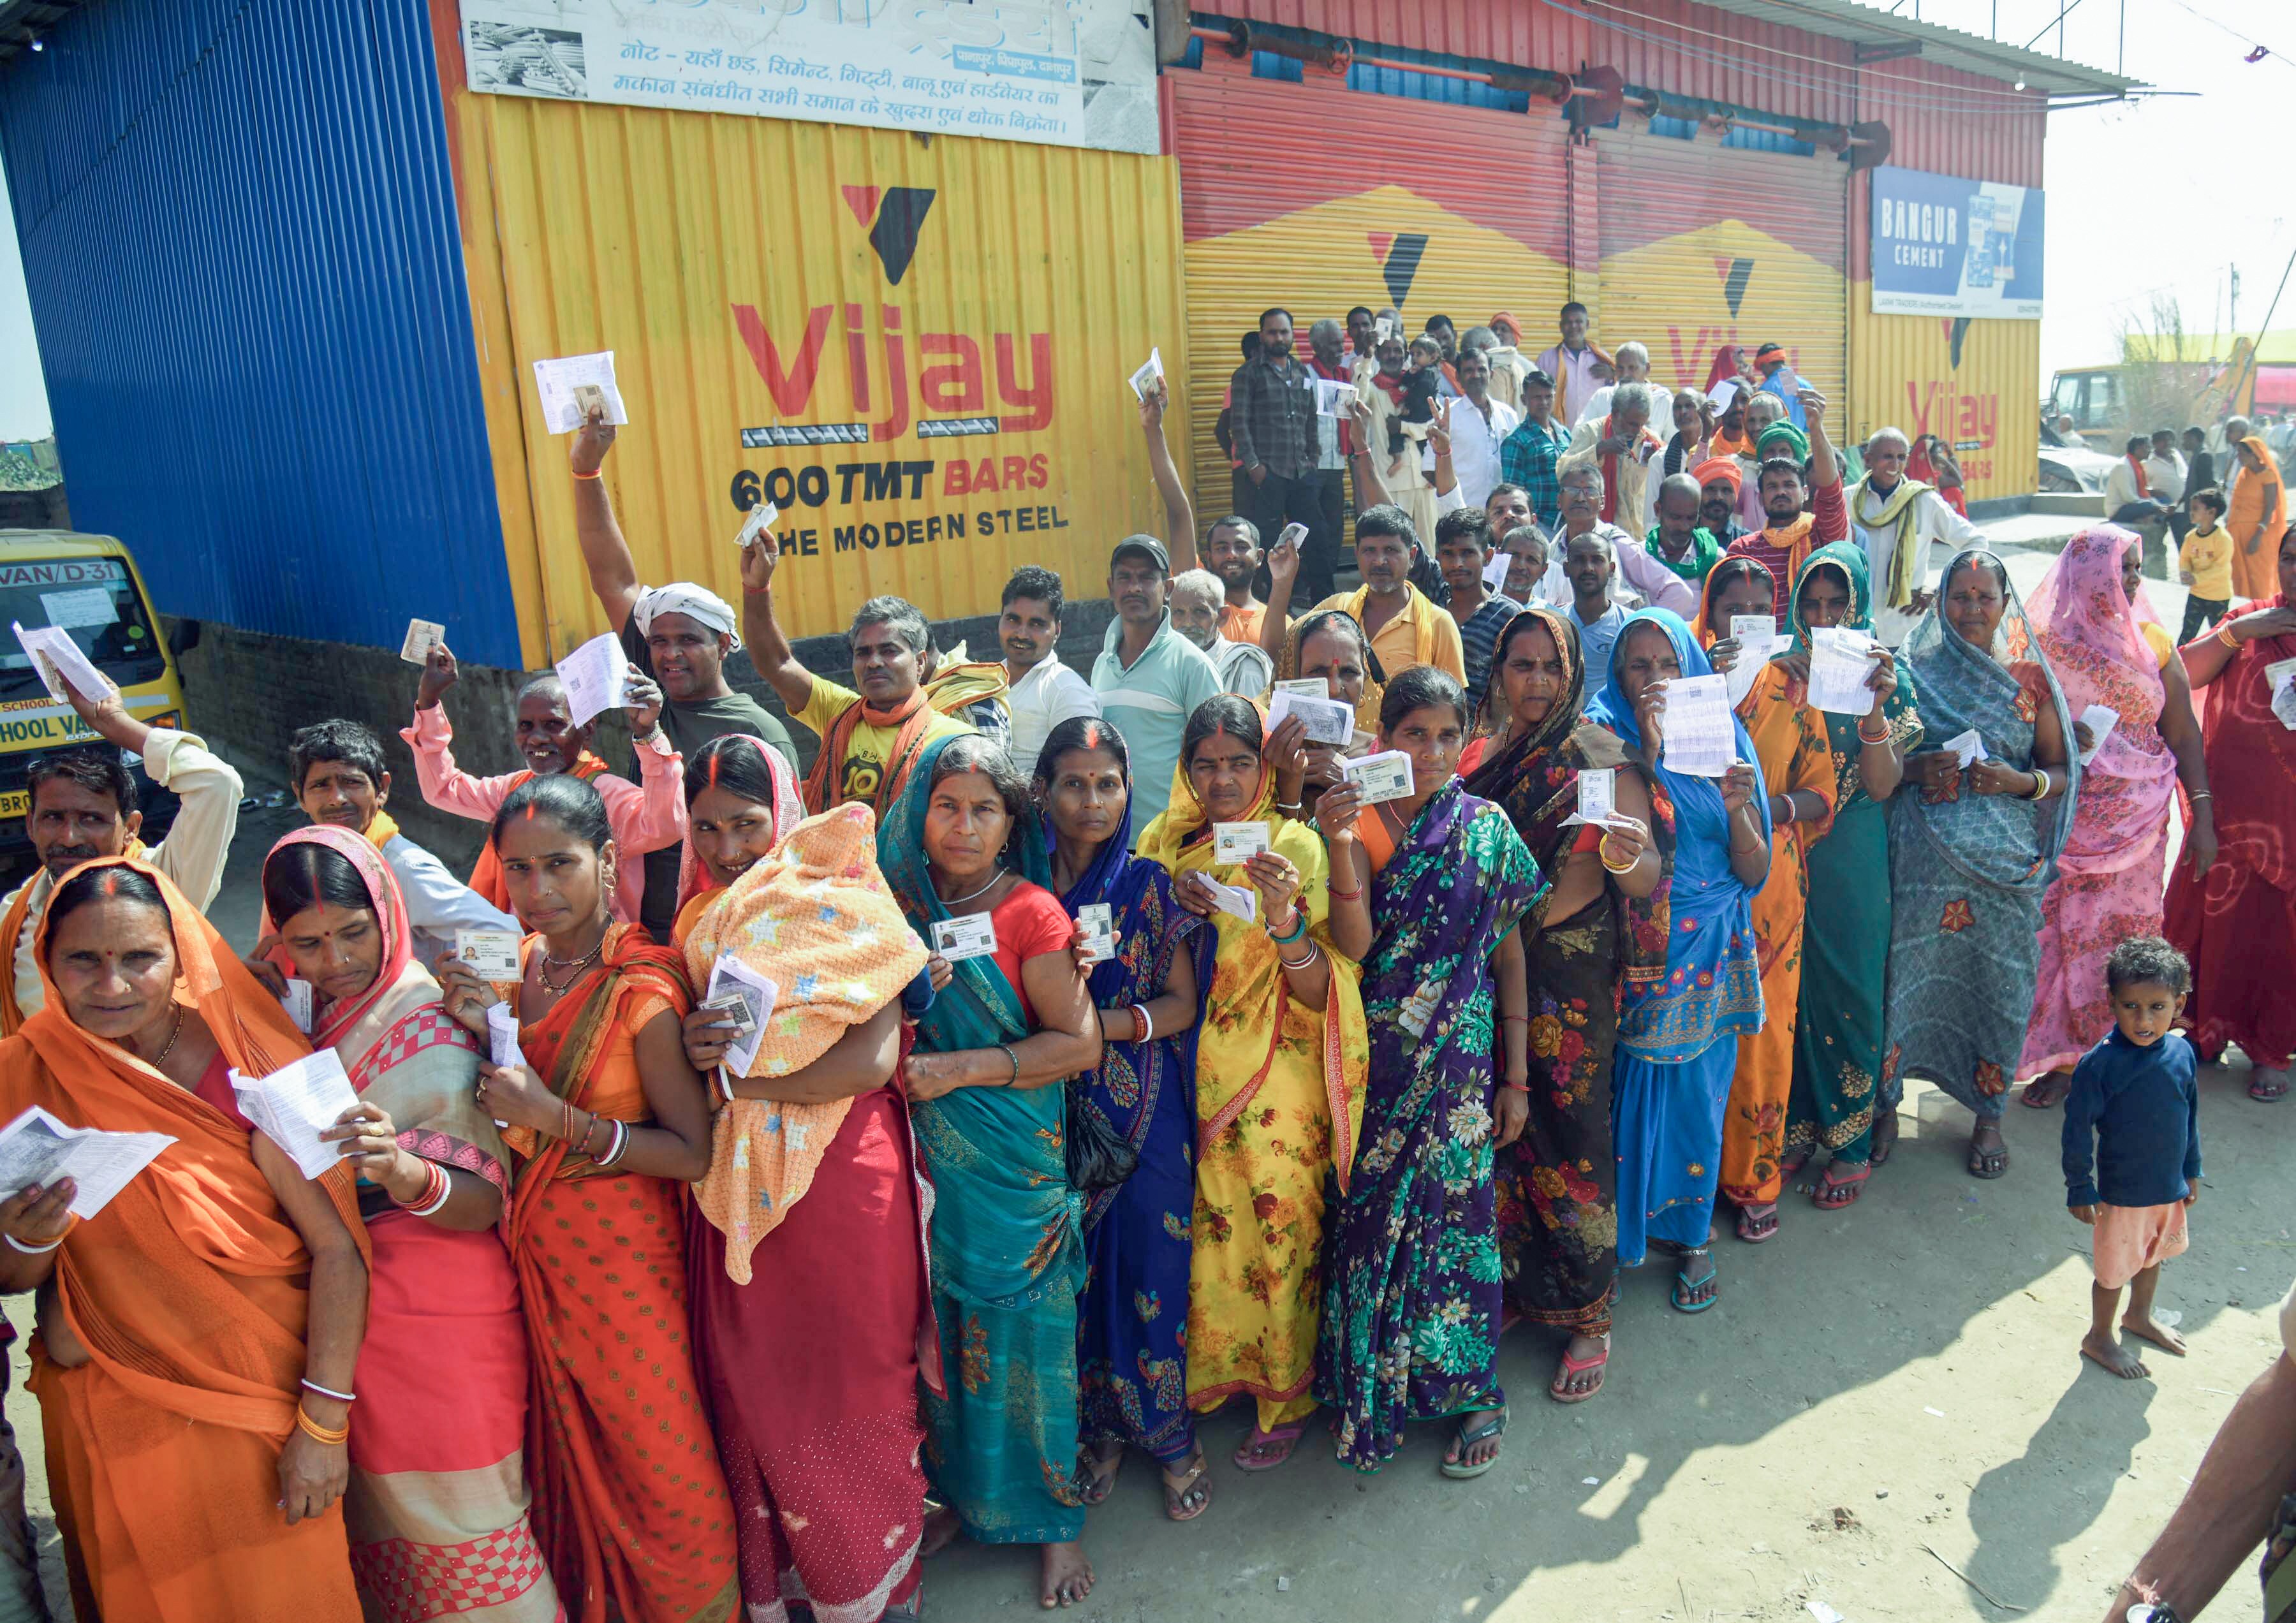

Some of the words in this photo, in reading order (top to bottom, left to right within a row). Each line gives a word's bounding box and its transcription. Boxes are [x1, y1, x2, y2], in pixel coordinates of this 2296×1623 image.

[620, 38, 660, 61] नोट
[684, 48, 723, 68] यहाँ
[902, 75, 939, 98] बालू
[940, 78, 968, 99] एवं
[969, 81, 1034, 103] हार्डवेयर
[1037, 92, 1060, 106] का
[613, 74, 677, 95] मकान
[758, 87, 798, 106] सभी
[804, 92, 856, 112] समान
[860, 96, 880, 114] के
[885, 101, 935, 122] खुदरा
[938, 106, 966, 127] एवं
[967, 107, 1005, 127] थोक
[1881, 197, 1957, 246] BANGUR
[1894, 244, 1945, 268] CEMENT
[730, 303, 1053, 443] Vijay
[1906, 381, 1998, 450] Vijay
[943, 453, 1049, 497] BARS
[777, 528, 820, 556] HE
[834, 513, 965, 553] MODERN
[978, 506, 1069, 537] STEEL
[3, 699, 55, 712] SCHOOL
[58, 713, 93, 735] VA
[66, 730, 103, 742] expre
